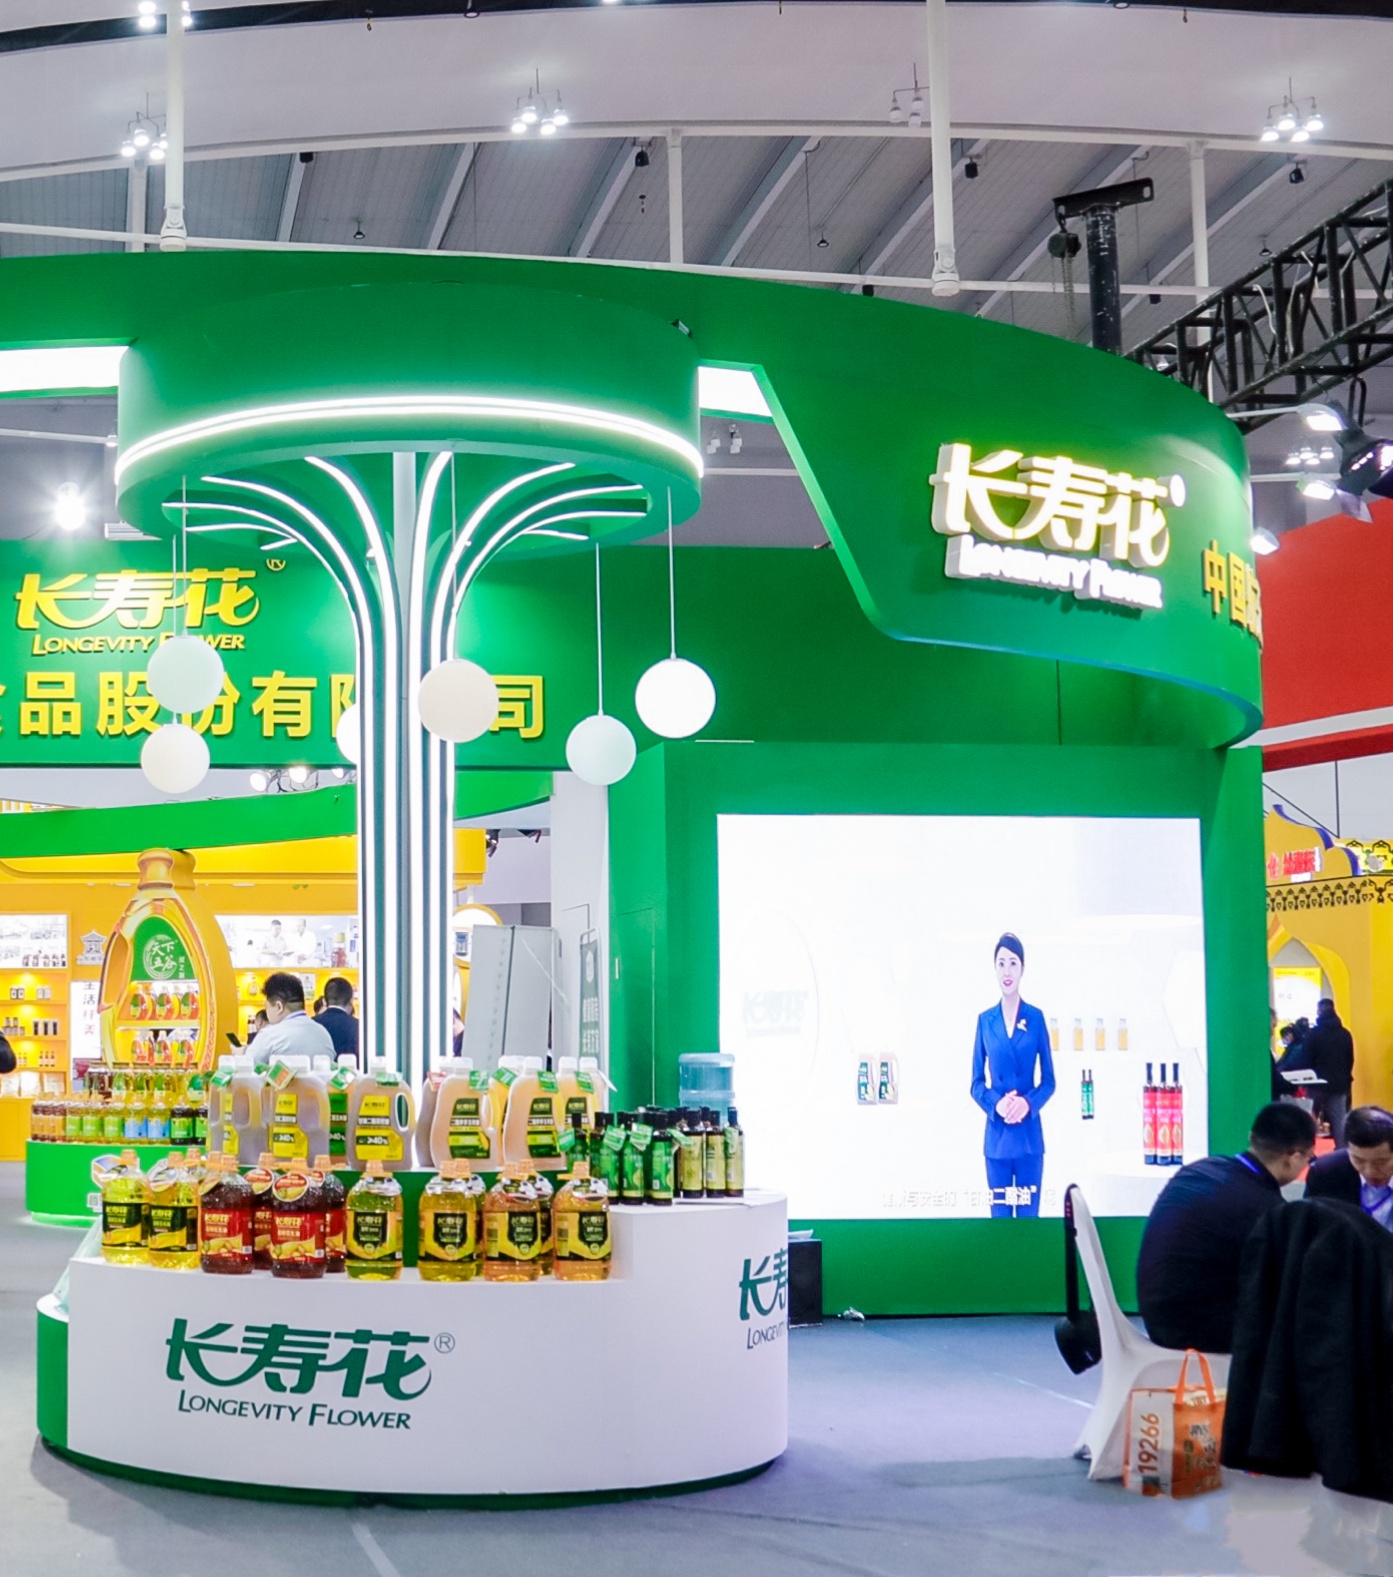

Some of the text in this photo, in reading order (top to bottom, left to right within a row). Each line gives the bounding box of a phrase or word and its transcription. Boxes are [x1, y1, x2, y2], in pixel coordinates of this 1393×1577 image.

[929, 442, 1170, 567] 长寿花
[15, 568, 260, 629] 长寿花
[1203, 540, 1263, 641] 中国
[32, 631, 245, 656] LONGEVITY FWER
[165, 1318, 432, 1401] 长寿花
[178, 1389, 412, 1430] LONGEVITY FLOWER
[1137, 1413, 1160, 1474] 19266
